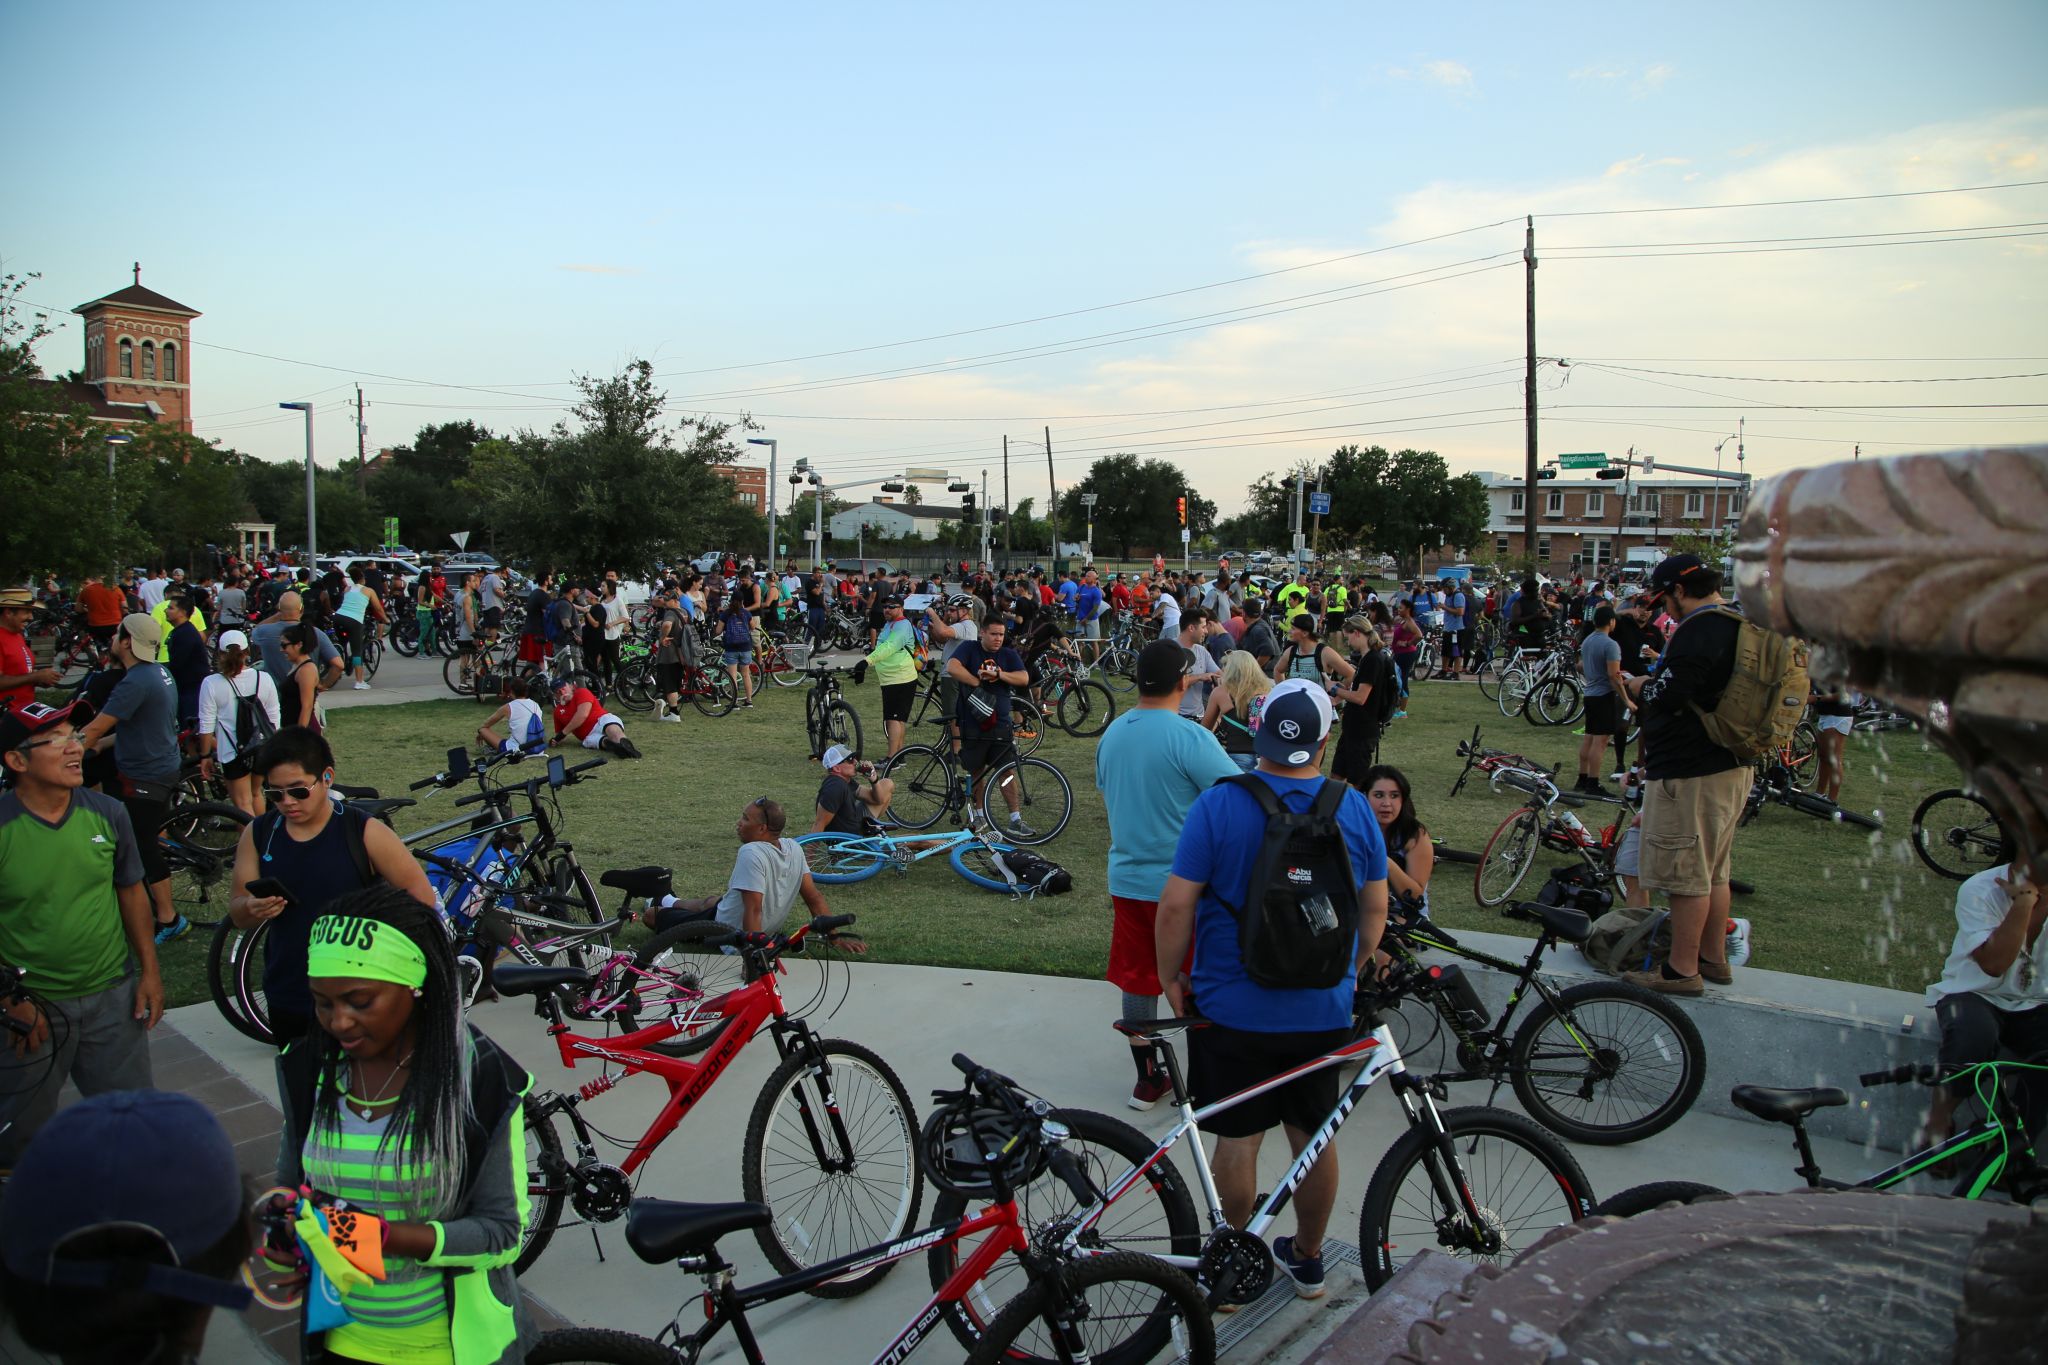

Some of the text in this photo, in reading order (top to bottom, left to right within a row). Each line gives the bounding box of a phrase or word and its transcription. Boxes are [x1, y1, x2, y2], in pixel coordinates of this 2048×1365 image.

[1287, 872, 1313, 881] Garcia
[1287, 1087, 1354, 1195] GIANT
[886, 1228, 946, 1258] RIDGE
[917, 1305, 940, 1332] 500
